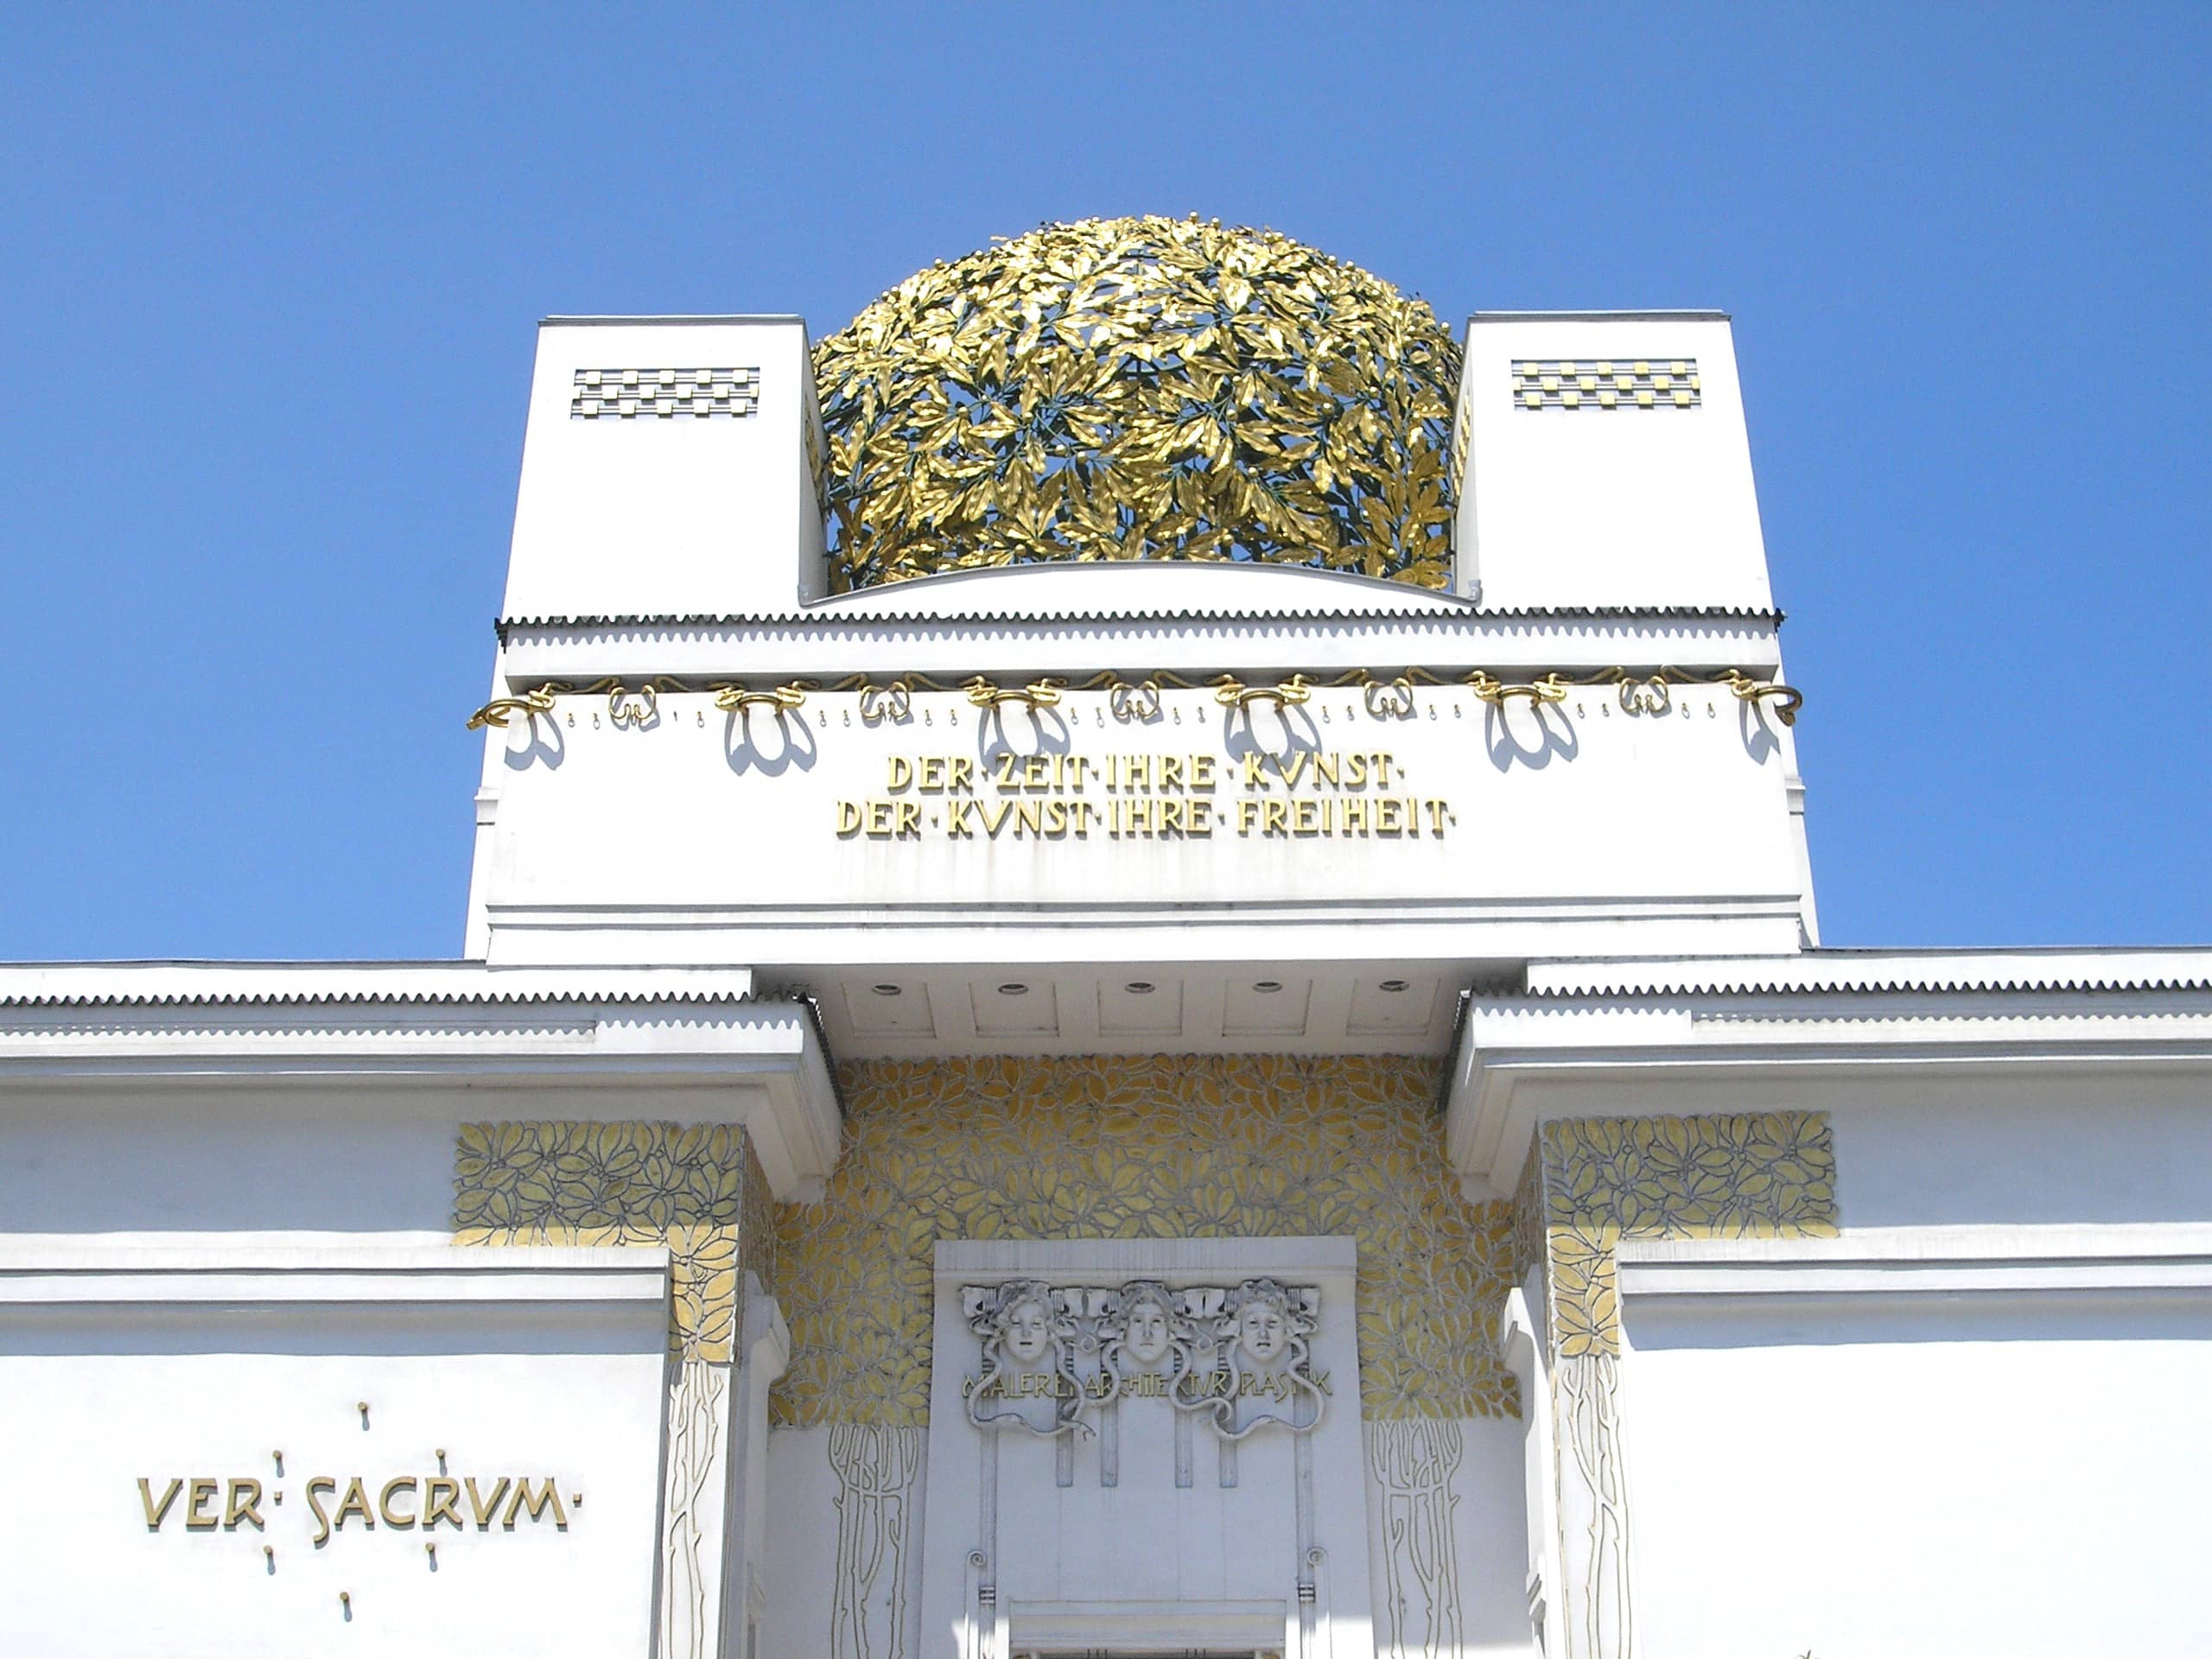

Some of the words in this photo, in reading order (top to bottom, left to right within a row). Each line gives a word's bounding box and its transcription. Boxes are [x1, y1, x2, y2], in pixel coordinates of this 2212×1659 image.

[887, 756, 972, 793] DER
[995, 753, 1088, 792] ZEIT
[1106, 753, 1215, 792] IHRE
[1243, 751, 1393, 791] KVNST
[836, 800, 921, 839] DER
[948, 799, 1090, 839] KVNST
[1108, 798, 1211, 838] IHRE
[1237, 798, 1447, 838] FREIHEIT
[137, 1478, 264, 1531] VER
[305, 1477, 568, 1548] SACRVM
